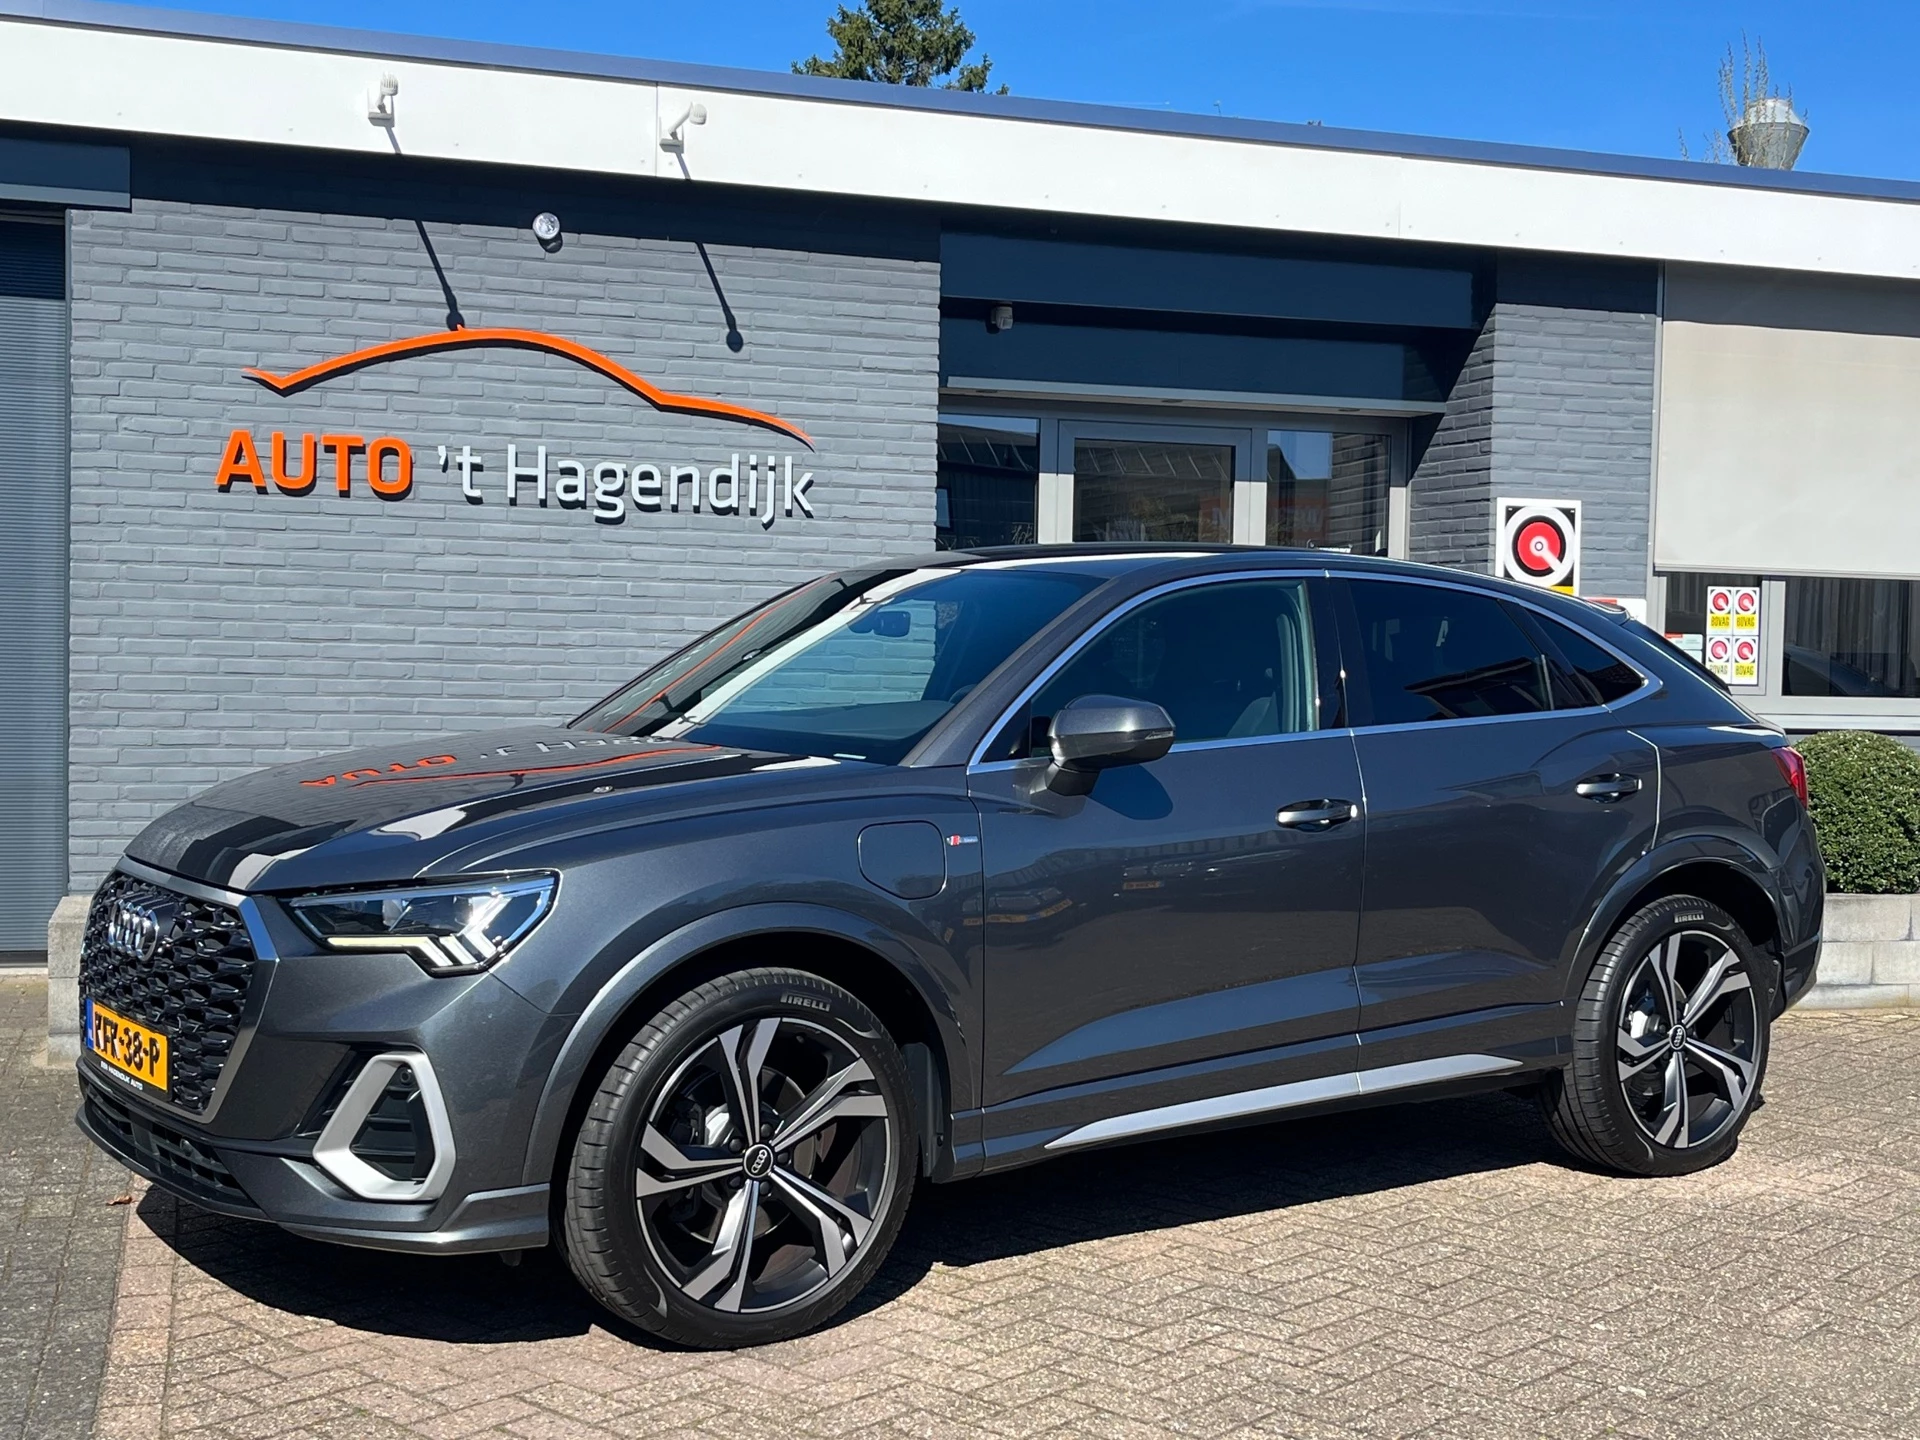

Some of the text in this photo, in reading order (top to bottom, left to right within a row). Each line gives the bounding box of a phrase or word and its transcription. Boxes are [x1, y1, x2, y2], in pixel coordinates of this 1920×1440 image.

[215, 429, 412, 495] AUTO
[507, 443, 814, 524] Hagendijk
[1711, 616, 1730, 627] BOVAG
[1736, 616, 1755, 627] BOVAG
[1735, 665, 1754, 676] BOVAG
[1674, 912, 1704, 923] PIRELLI
[780, 992, 831, 1012] PIRELLI
